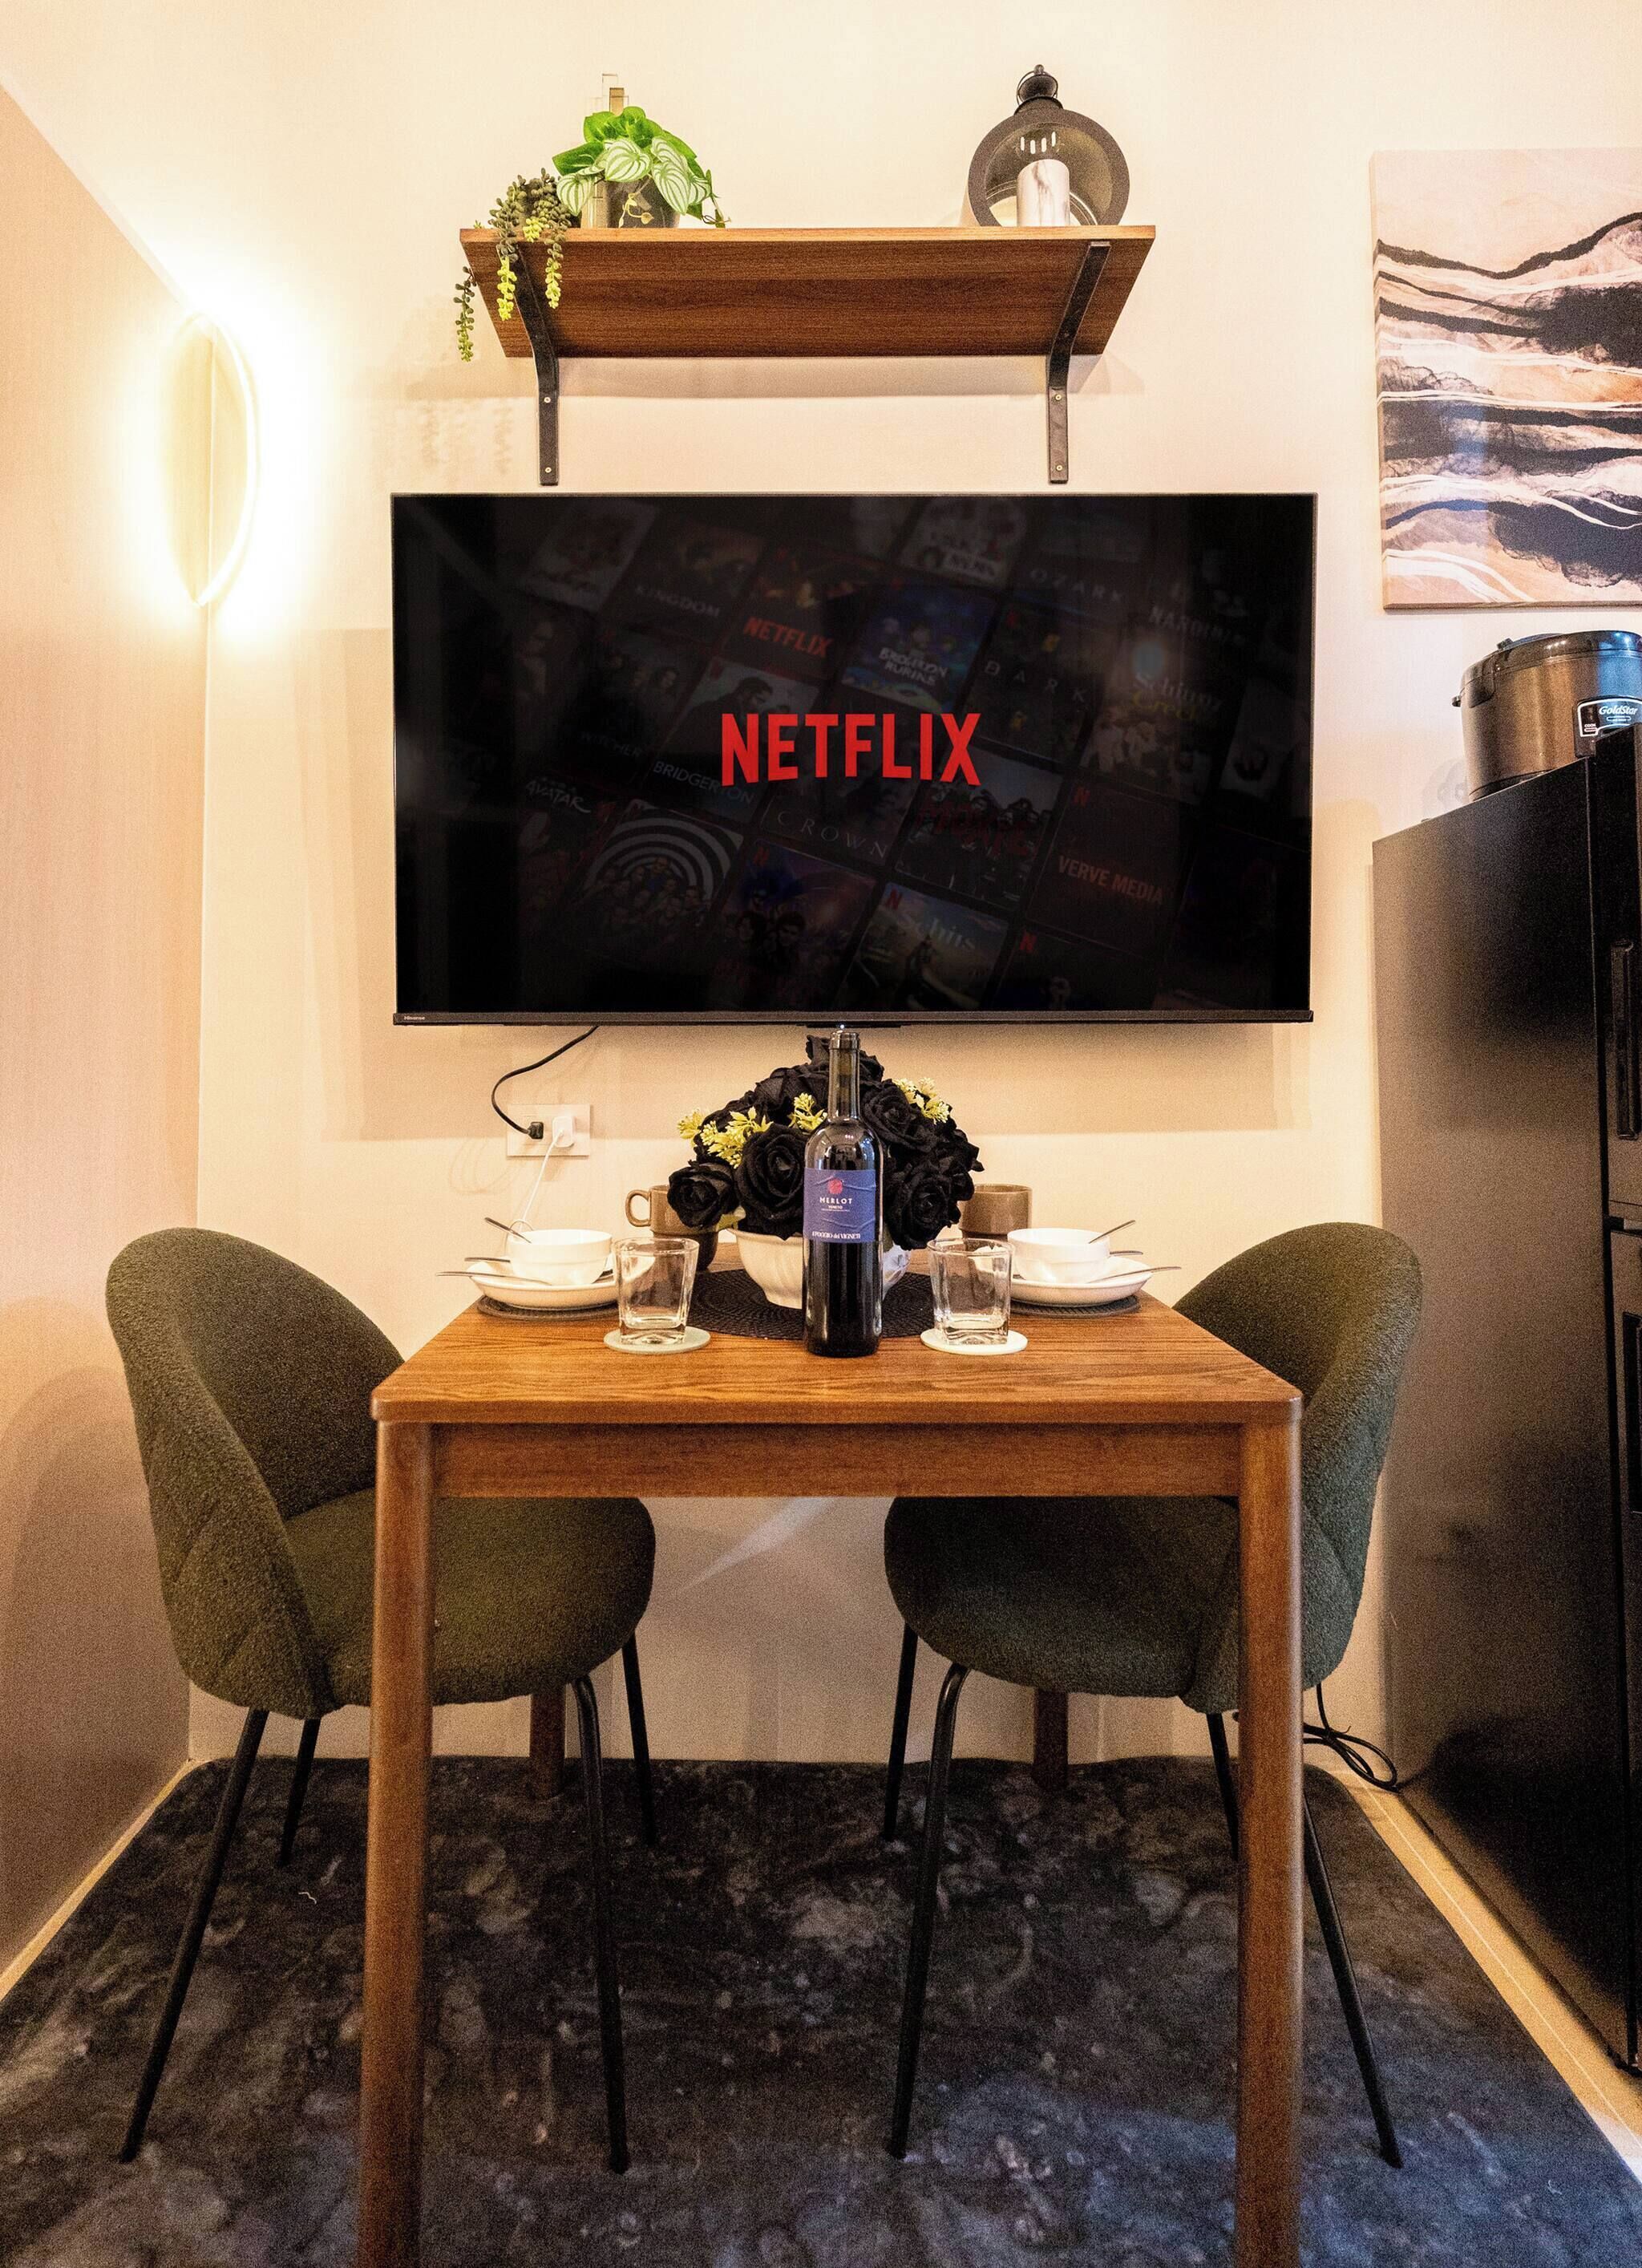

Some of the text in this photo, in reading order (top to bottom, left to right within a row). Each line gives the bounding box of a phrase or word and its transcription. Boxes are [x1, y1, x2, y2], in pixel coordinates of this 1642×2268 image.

[742, 617, 834, 658] NETFLIX
[985, 660, 1087, 704] DARK
[1599, 705, 1639, 715] GoldStar
[721, 713, 981, 788] NETFLIX
[525, 778, 592, 813] AVATAR
[653, 759, 754, 804] BRIDGERON
[777, 810, 889, 860] CROWN
[1058, 856, 1165, 906] VERVE MEDIA
[819, 1197, 853, 1205] MERLOT
